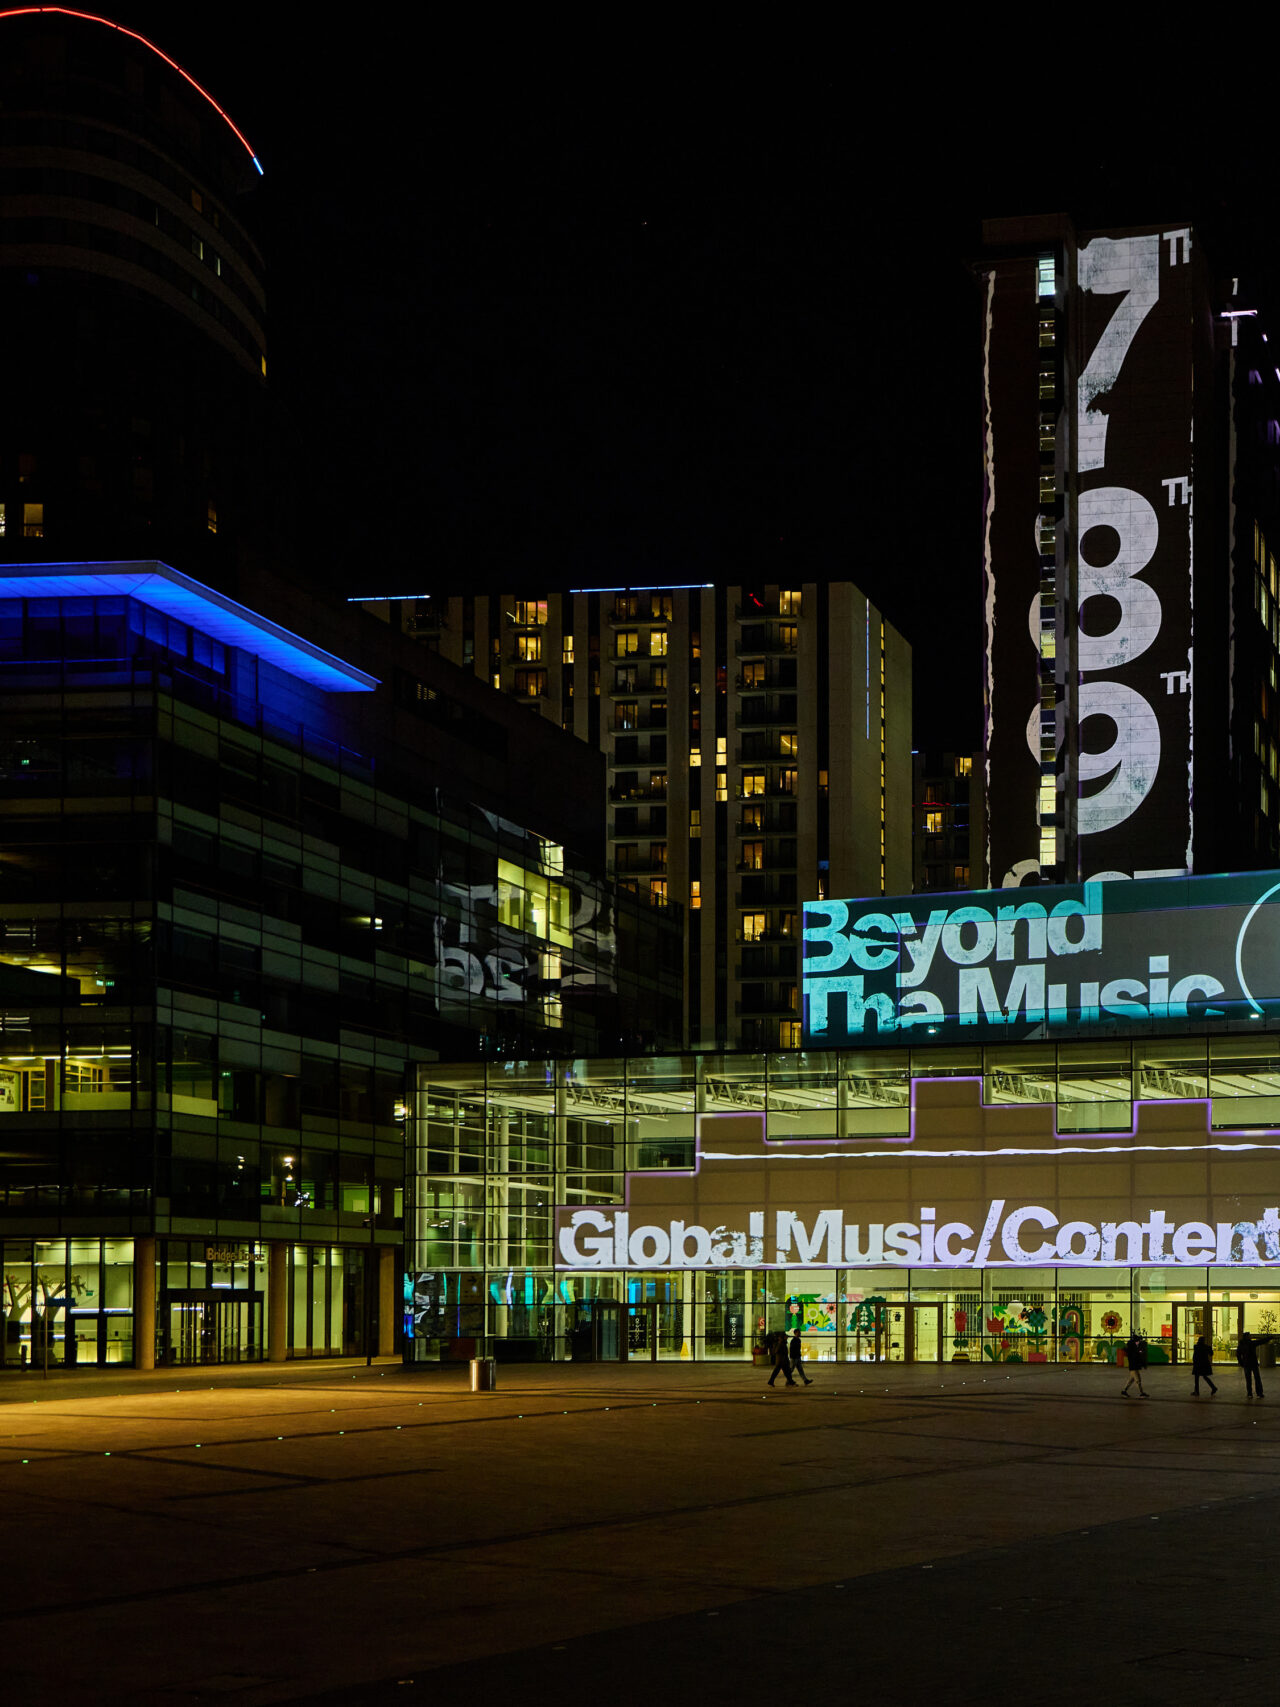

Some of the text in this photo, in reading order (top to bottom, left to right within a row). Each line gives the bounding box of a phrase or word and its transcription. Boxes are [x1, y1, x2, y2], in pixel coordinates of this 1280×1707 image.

[802, 880, 1103, 988] Beyond
[802, 955, 1227, 1036] The Music
[205, 1247, 237, 1264] Bridge
[558, 1209, 766, 1266] Global
